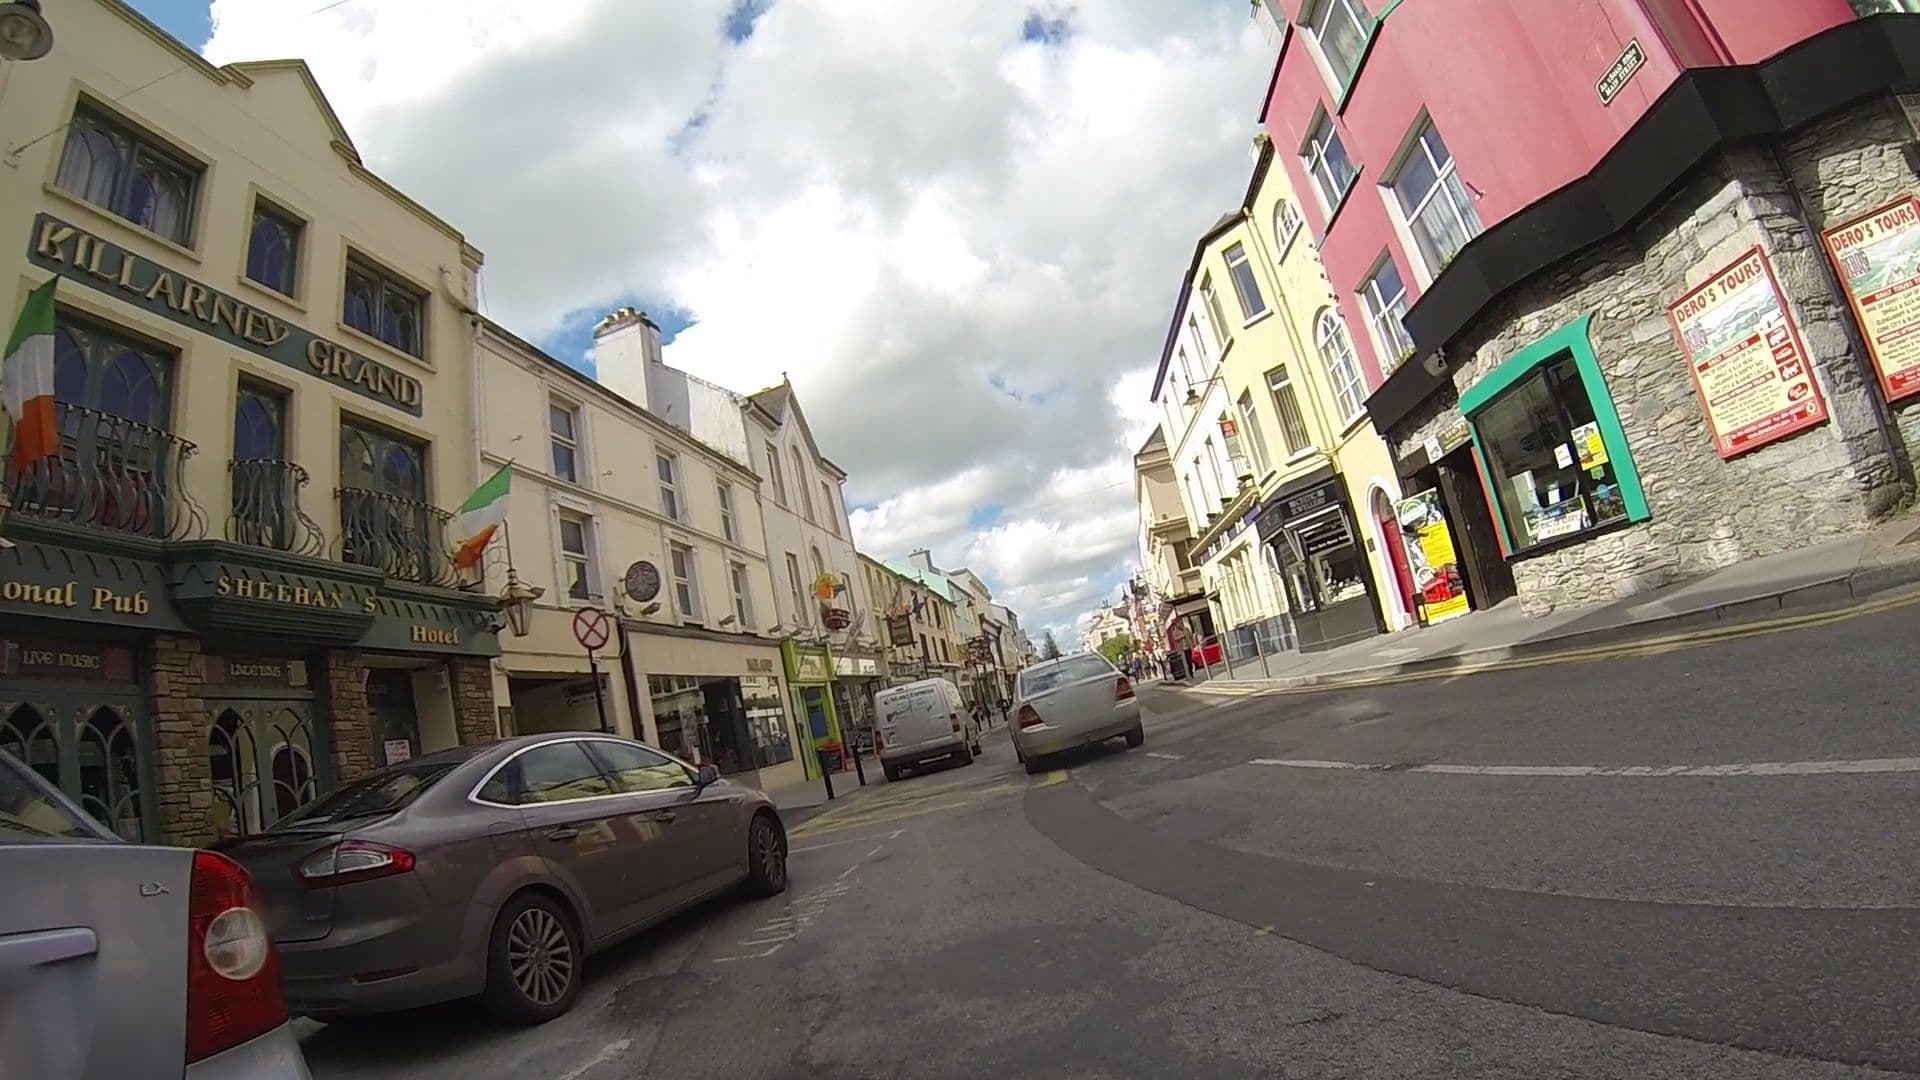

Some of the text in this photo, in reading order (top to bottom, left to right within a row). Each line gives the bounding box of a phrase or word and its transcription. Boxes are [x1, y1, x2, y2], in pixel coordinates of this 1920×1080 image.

[1832, 206, 1915, 252] DERO'S TOURS
[1676, 258, 1762, 323] DERO'S TOURS
[37, 222, 421, 406] KILLARNEY GRAND
[90, 586, 149, 614] Pub
[411, 624, 460, 645] Hotel
